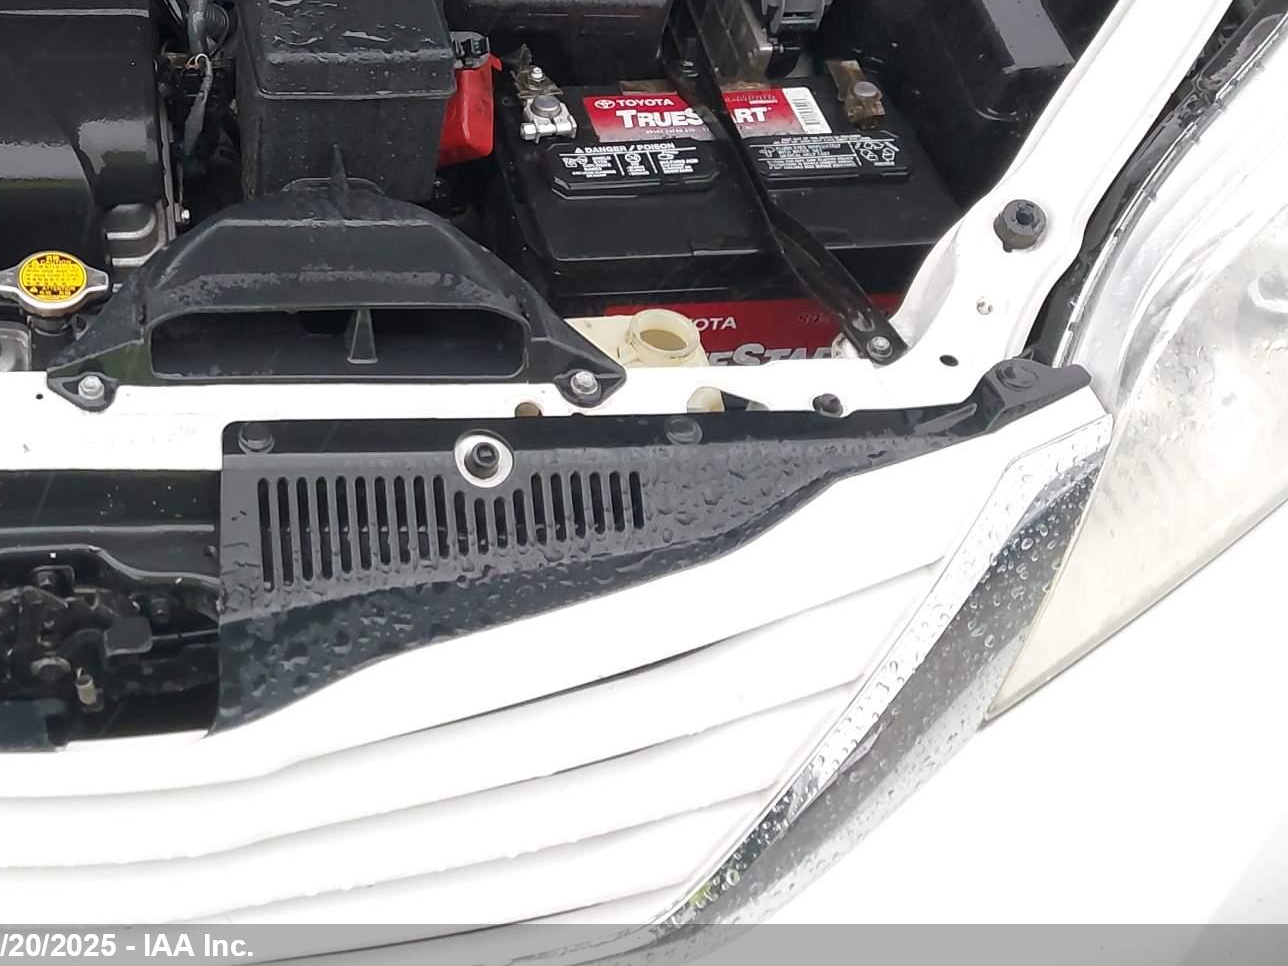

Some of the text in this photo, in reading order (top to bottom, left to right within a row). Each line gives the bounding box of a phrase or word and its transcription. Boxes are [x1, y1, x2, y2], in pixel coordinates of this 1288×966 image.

[616, 98, 675, 108] TOYOTA
[585, 145, 627, 153] DANGER
[636, 142, 676, 151] POISON
